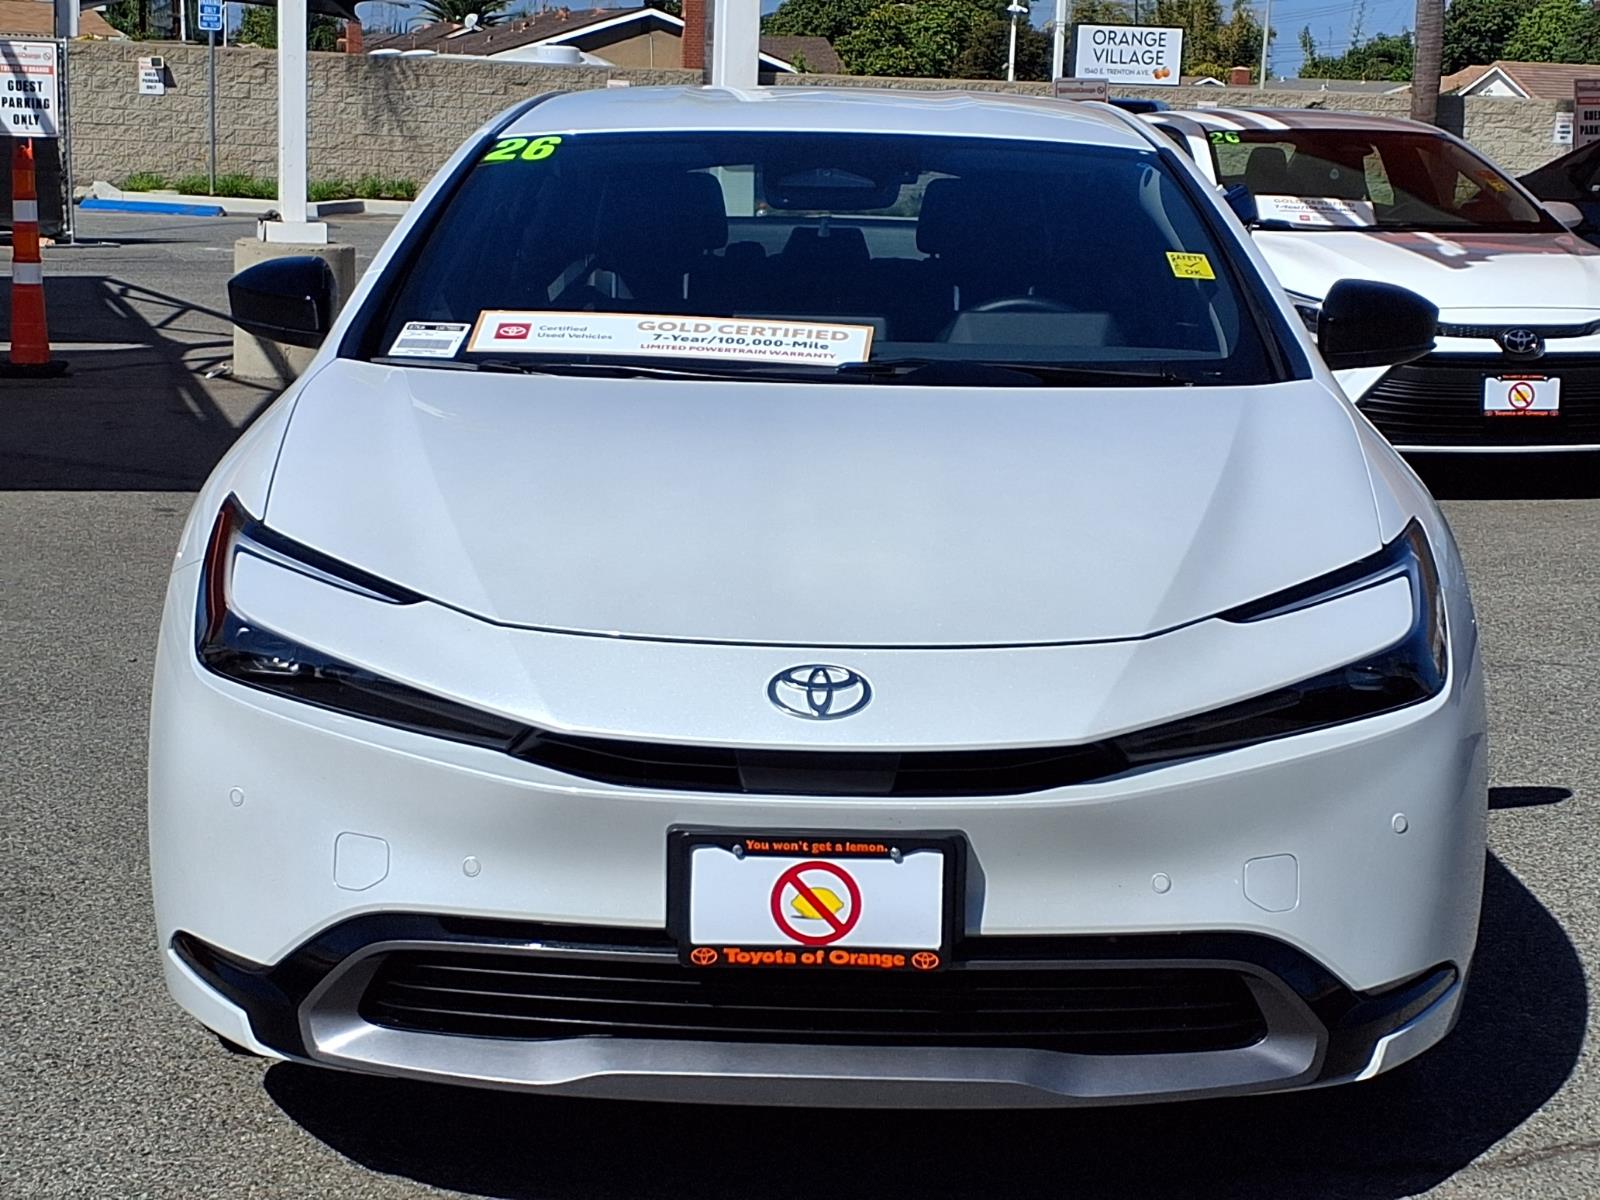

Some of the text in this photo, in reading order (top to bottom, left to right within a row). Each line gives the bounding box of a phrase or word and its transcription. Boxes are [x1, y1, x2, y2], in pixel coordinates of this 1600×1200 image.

[1092, 29, 1168, 48] ORANGE
[1093, 48, 1165, 66] VILLAGE
[1107, 68, 1135, 76] TRENTON
[7, 79, 43, 93] GUEST
[1, 96, 50, 110] PARKING
[13, 113, 40, 126] ONLY
[1208, 131, 1241, 145] 26
[483, 136, 562, 161] 26
[1170, 254, 1204, 262] SAFETY
[538, 324, 588, 332] Certified
[637, 320, 850, 342] GOLD CERTIFIED
[652, 333, 830, 351] 7-Year/100,000-Mile
[640, 343, 837, 360] LIMITED POWERTRAIN WARRANTY
[746, 840, 889, 854] You won't get a lemon.
[723, 948, 905, 967] Toyota of Orange
